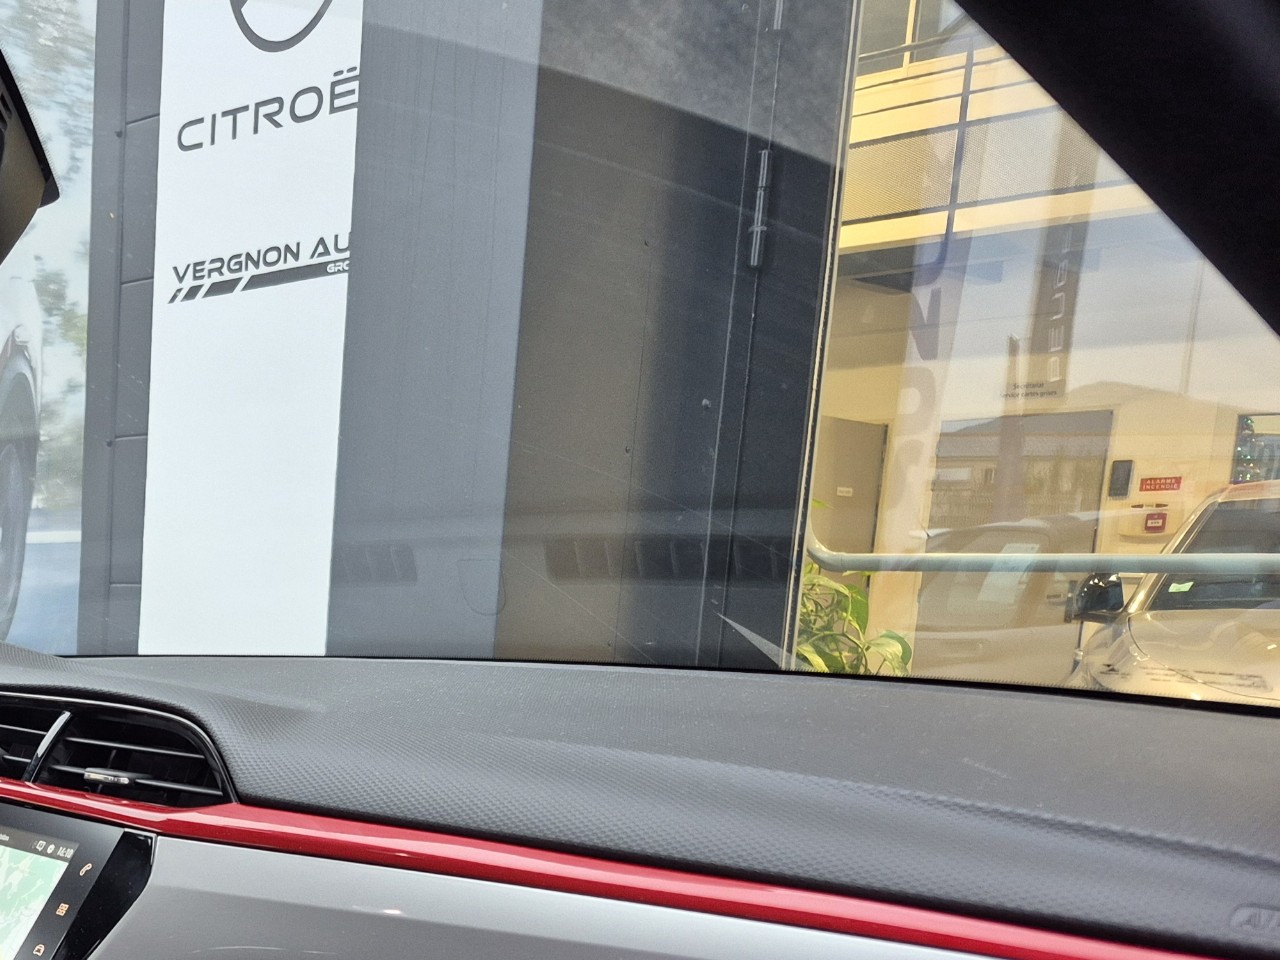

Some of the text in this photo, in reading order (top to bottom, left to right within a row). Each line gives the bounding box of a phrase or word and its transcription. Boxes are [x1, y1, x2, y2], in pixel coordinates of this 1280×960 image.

[177, 66, 360, 152] CITROË
[173, 242, 300, 284] VERGNON
[1142, 483, 1179, 491] INCENDIE
